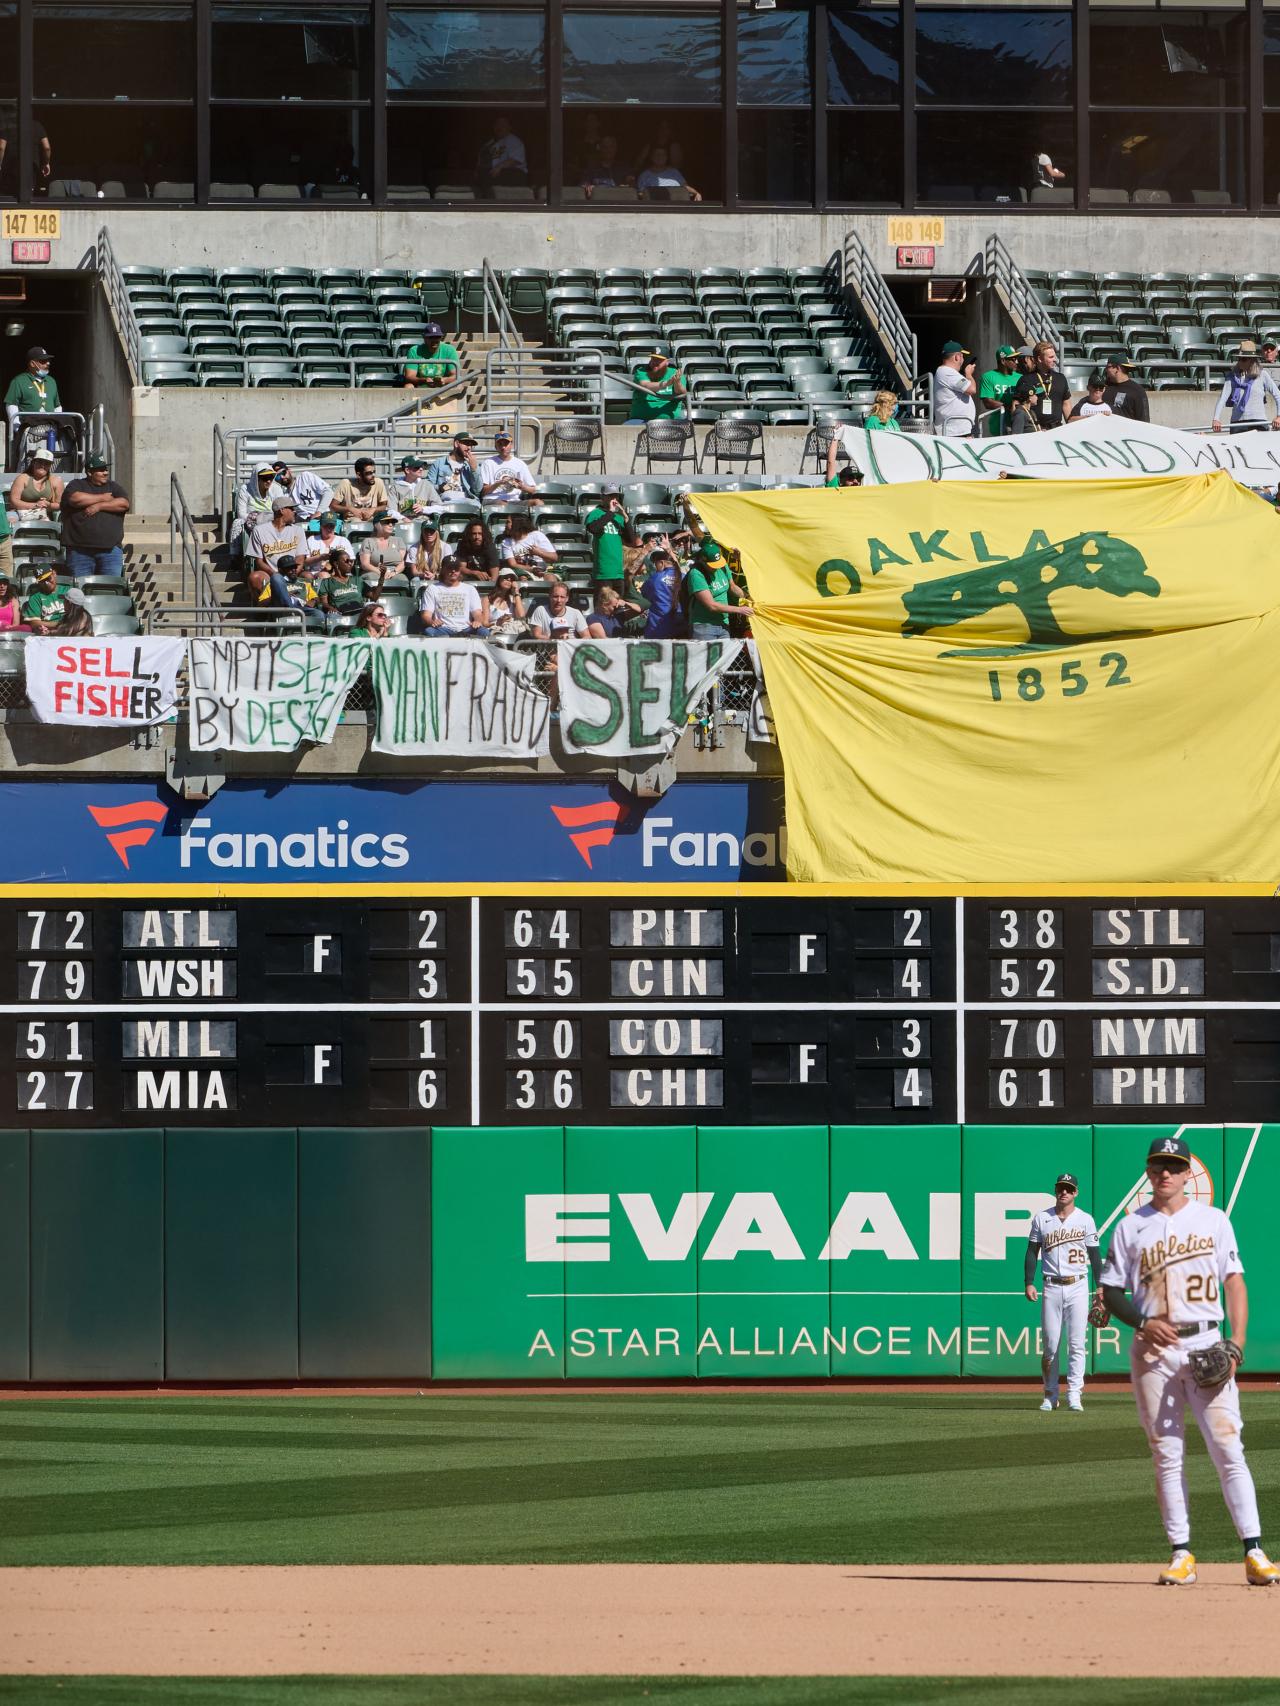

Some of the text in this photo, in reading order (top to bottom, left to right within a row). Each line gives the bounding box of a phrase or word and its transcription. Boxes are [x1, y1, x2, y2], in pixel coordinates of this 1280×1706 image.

[5, 214, 57, 234] 147 148
[890, 222, 942, 241] 148 149
[903, 249, 930, 265] EXIT
[865, 429, 1178, 484] OAKLAND
[816, 529, 1054, 598] OAKLA
[374, 647, 440, 744] MAN
[987, 652, 1131, 702] 1852
[54, 680, 162, 720] FISHER
[198, 691, 334, 747] BY DESIG
[180, 818, 410, 868] Fanatics
[28, 910, 438, 949] 72 ATL 2
[513, 909, 922, 948] 64 PIT 2
[1000, 909, 1056, 948] 38
[1107, 909, 1190, 945] STL
[313, 935, 332, 972] F
[799, 934, 817, 972] F
[28, 959, 438, 999] 79 WSH 3
[516, 958, 922, 997] 55 CIN 4
[1000, 958, 1056, 997] 52
[1107, 958, 1189, 995] S.D.
[26, 1019, 436, 1060] 51 MIL 1
[516, 1019, 921, 1059] 50 COL 3
[1002, 1018, 1197, 1058] 70 NYM
[314, 1045, 332, 1083] F
[799, 1044, 817, 1082] F
[27, 1069, 438, 1109] 27 MIA 6
[516, 1068, 922, 1109] 36 CHI 4
[998, 1068, 1185, 1107] 61 PHI
[525, 1192, 806, 1262] EVA
[1045, 1228, 1086, 1248] Athletics
[1068, 1248, 1086, 1265] 25
[1140, 1233, 1215, 1274] Athletics
[1185, 1274, 1218, 1302] 20
[527, 1326, 1121, 1357] A STAR ALLIANCE MEMR
